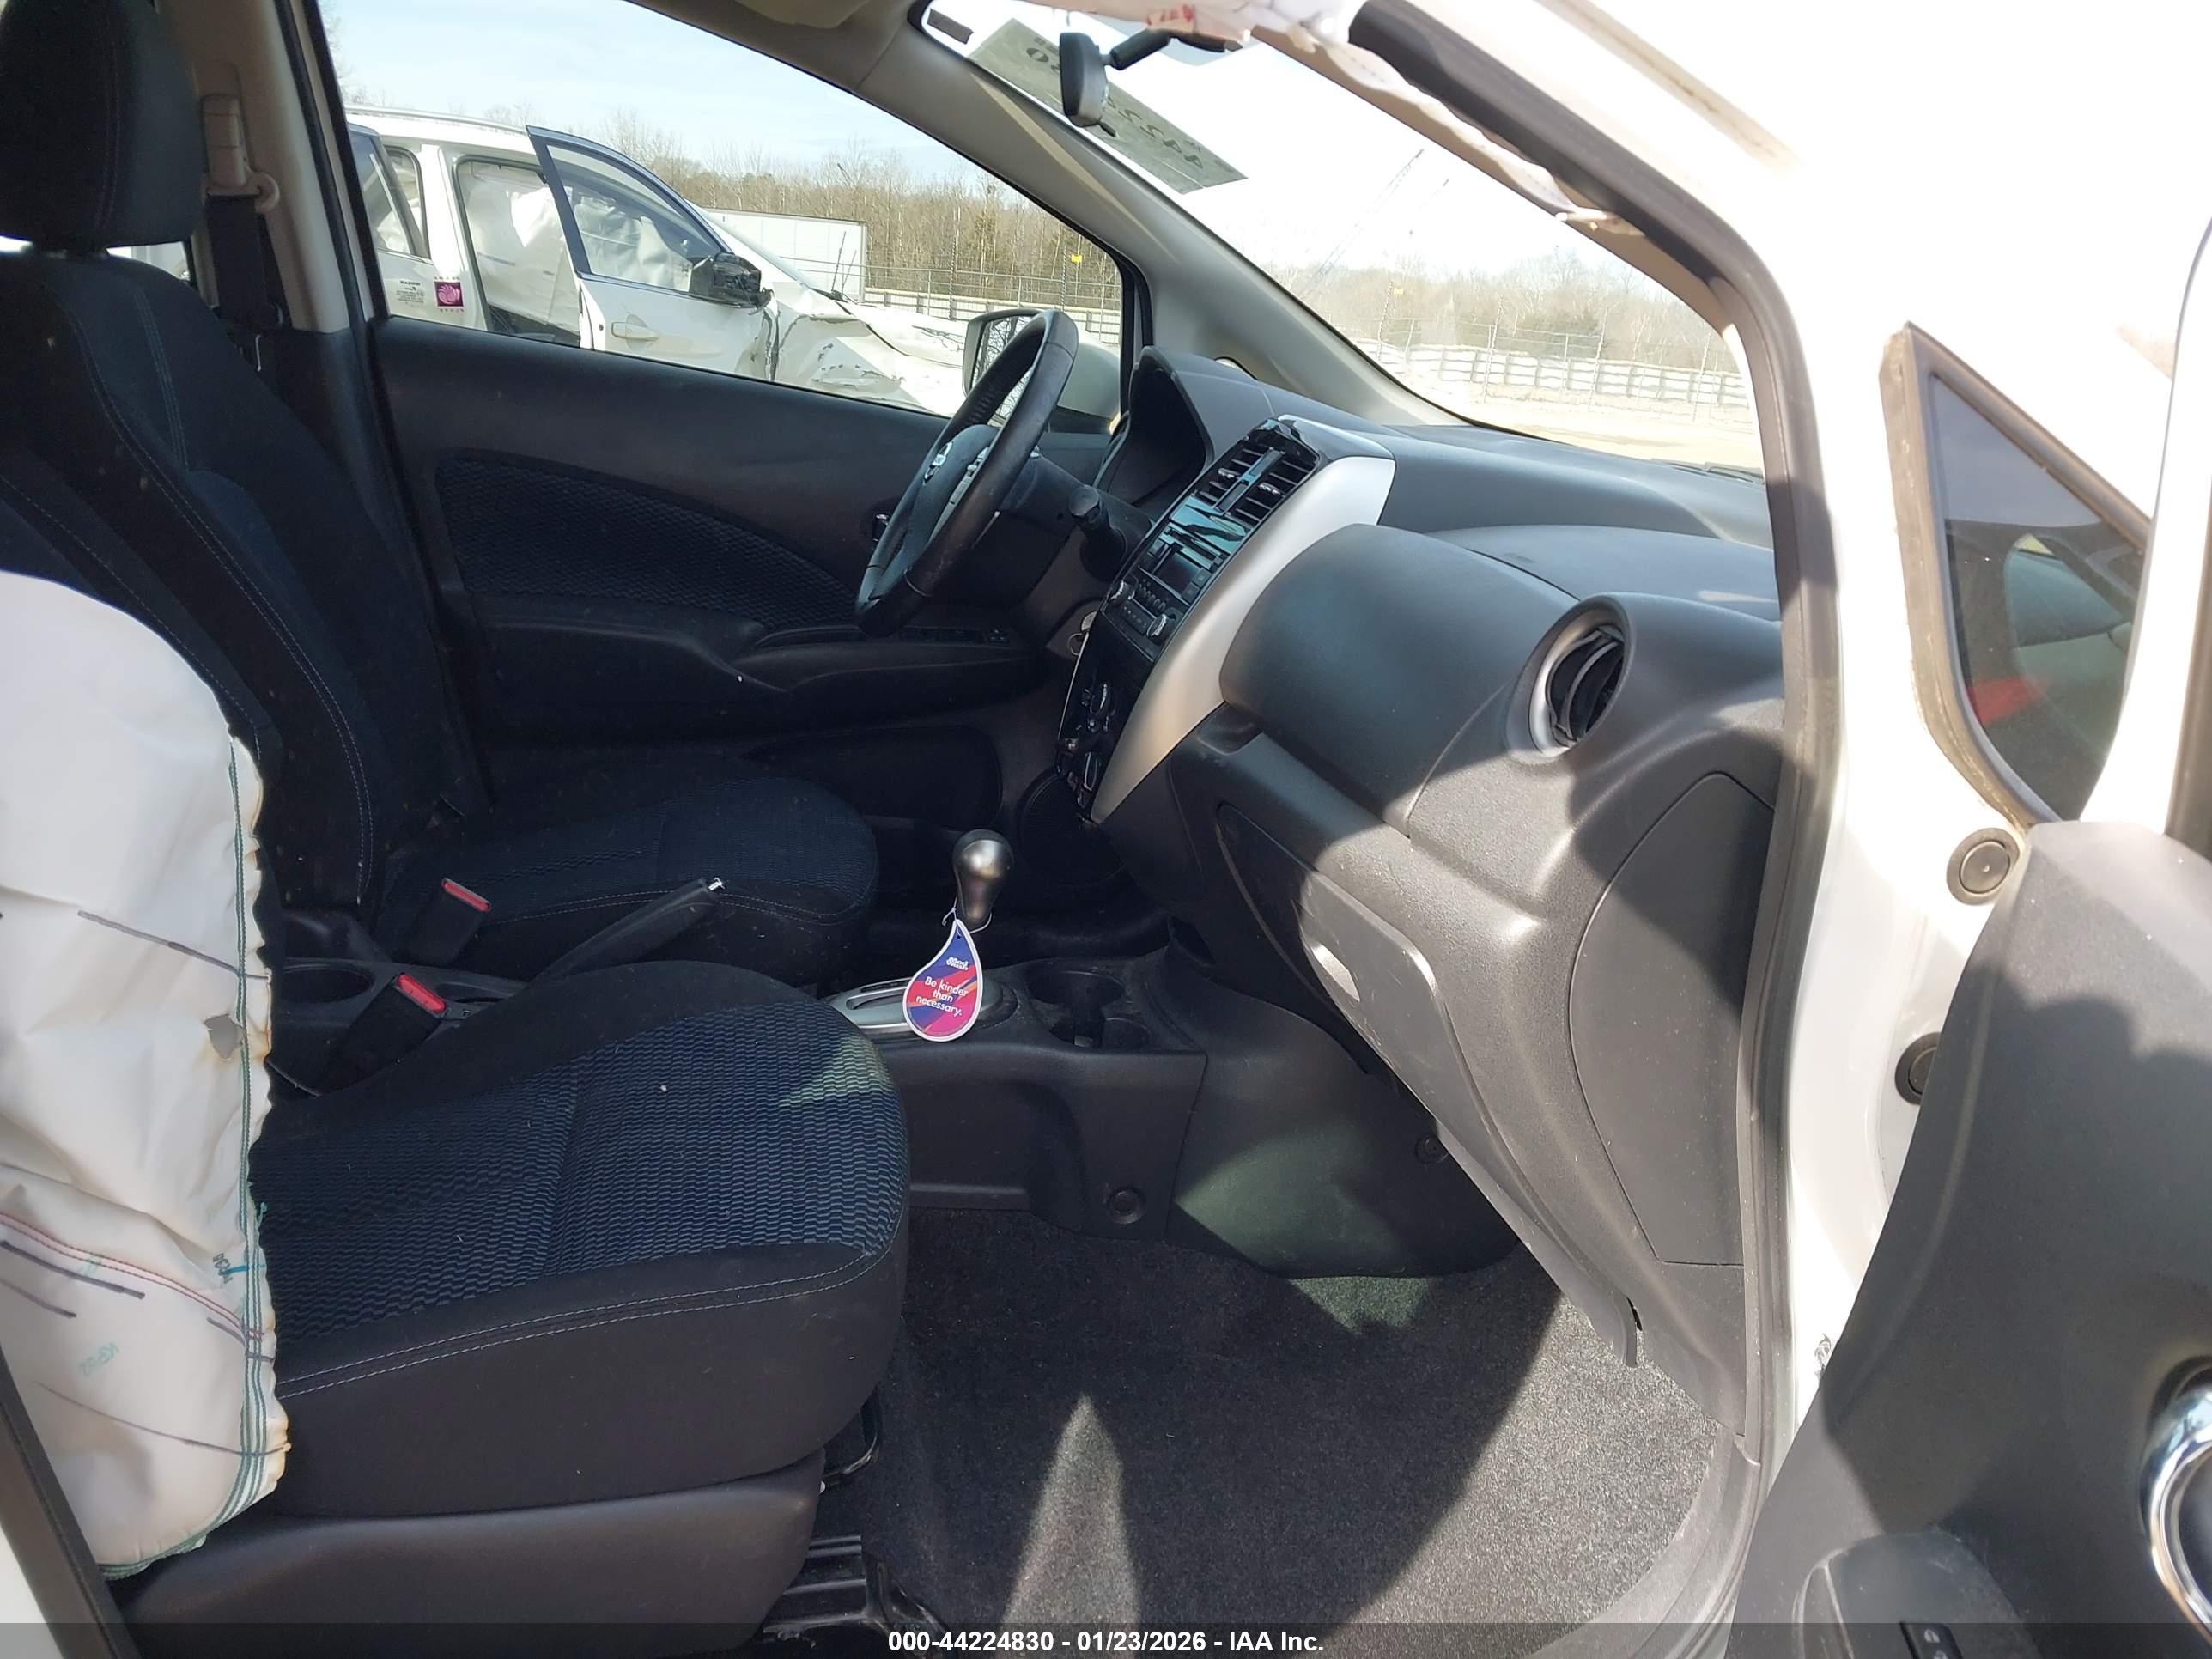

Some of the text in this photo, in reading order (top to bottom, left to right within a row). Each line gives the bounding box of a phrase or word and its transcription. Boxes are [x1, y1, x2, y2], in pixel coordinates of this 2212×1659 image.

[925, 976, 969, 996] Be kinder
[933, 989, 953, 1003] than
[915, 995, 963, 1017] necessary.
